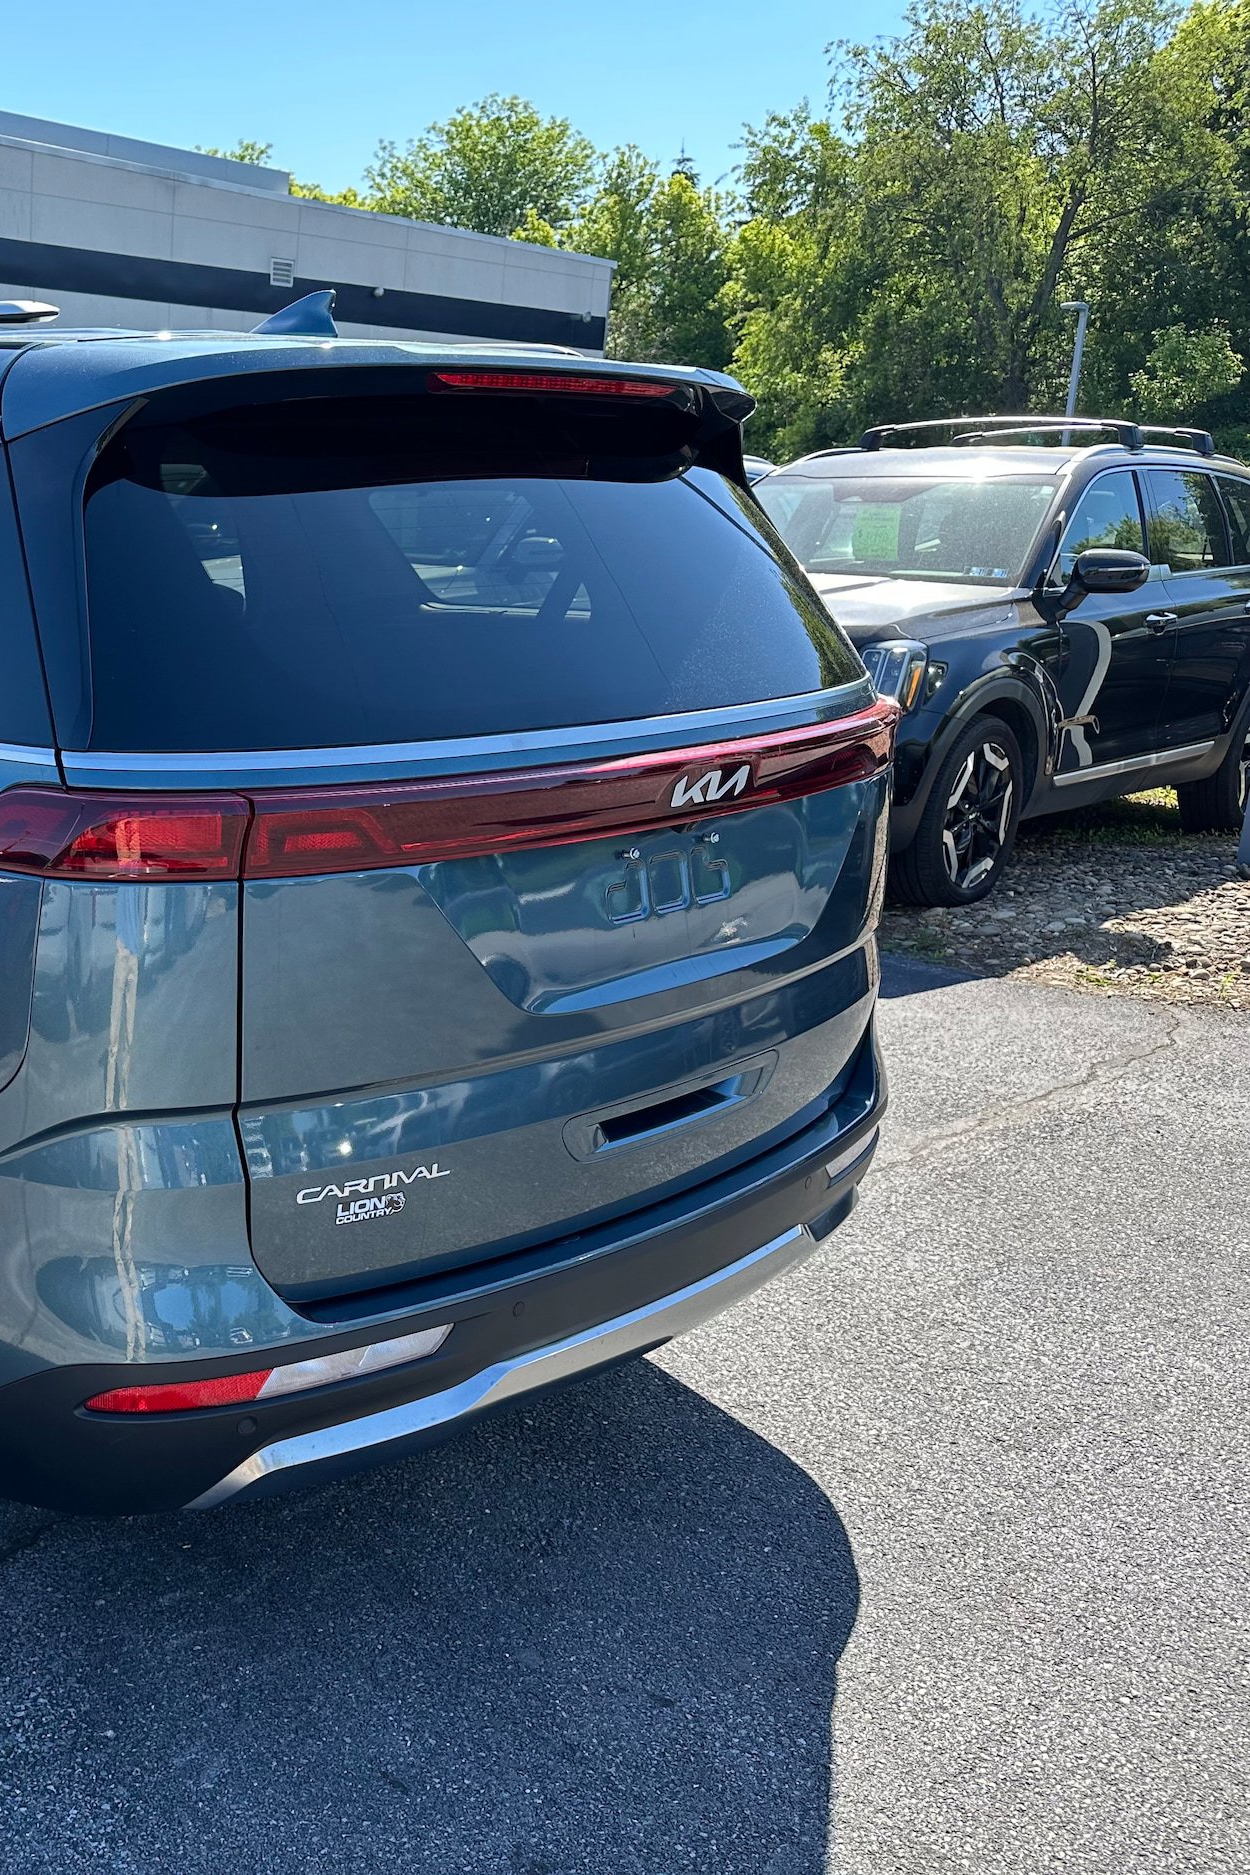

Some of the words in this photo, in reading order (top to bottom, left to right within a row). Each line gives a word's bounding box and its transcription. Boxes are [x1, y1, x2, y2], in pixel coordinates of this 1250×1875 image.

[670, 764, 751, 808] KIA
[296, 1163, 451, 1205] CARNIVAL
[335, 1207, 393, 1226] COUNTRY
[336, 1195, 387, 1218] LION
